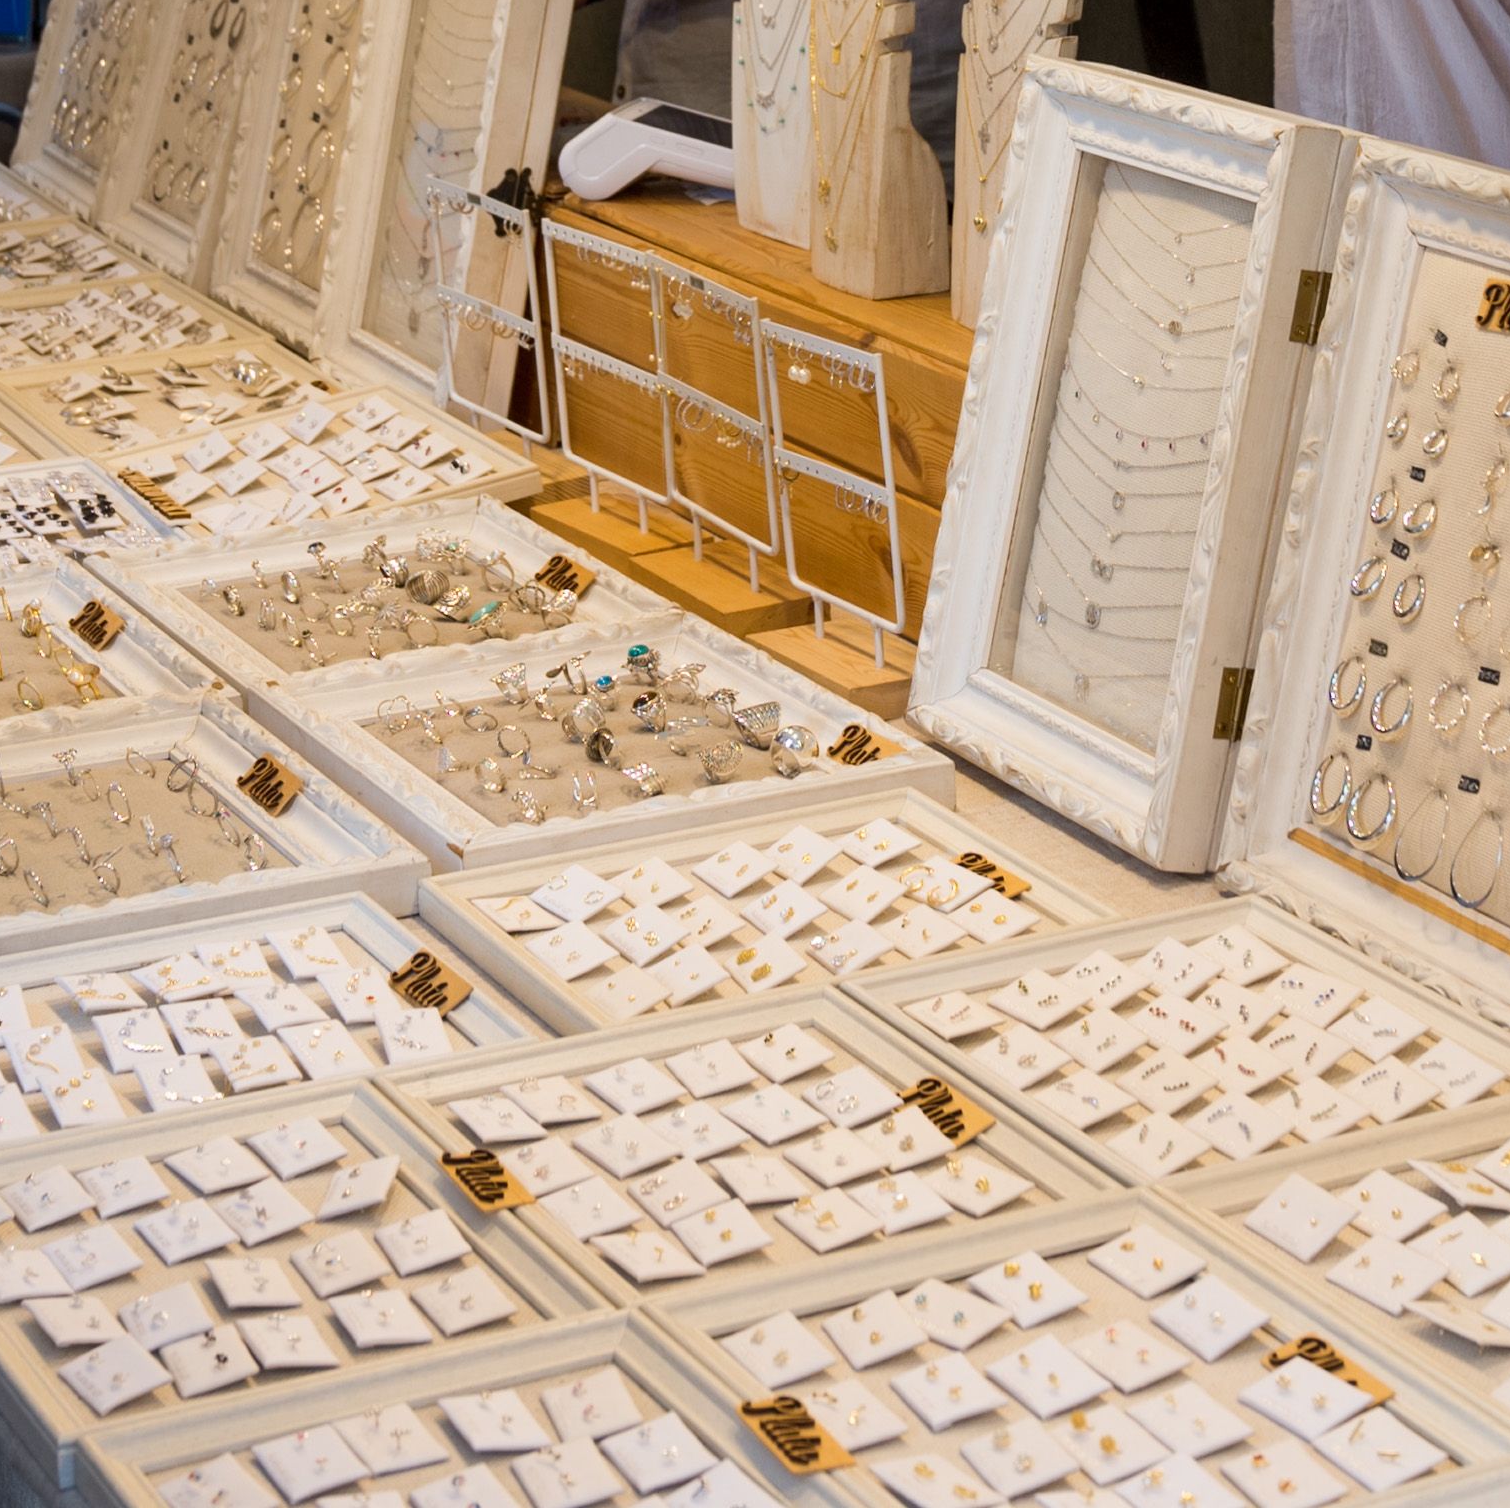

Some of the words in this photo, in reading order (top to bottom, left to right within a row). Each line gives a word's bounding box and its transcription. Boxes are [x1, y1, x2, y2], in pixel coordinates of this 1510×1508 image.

[68, 601, 108, 645] Plata
[236, 757, 285, 809] Plata
[442, 1149, 509, 1204] Plata
[741, 1395, 822, 1467] Plata
